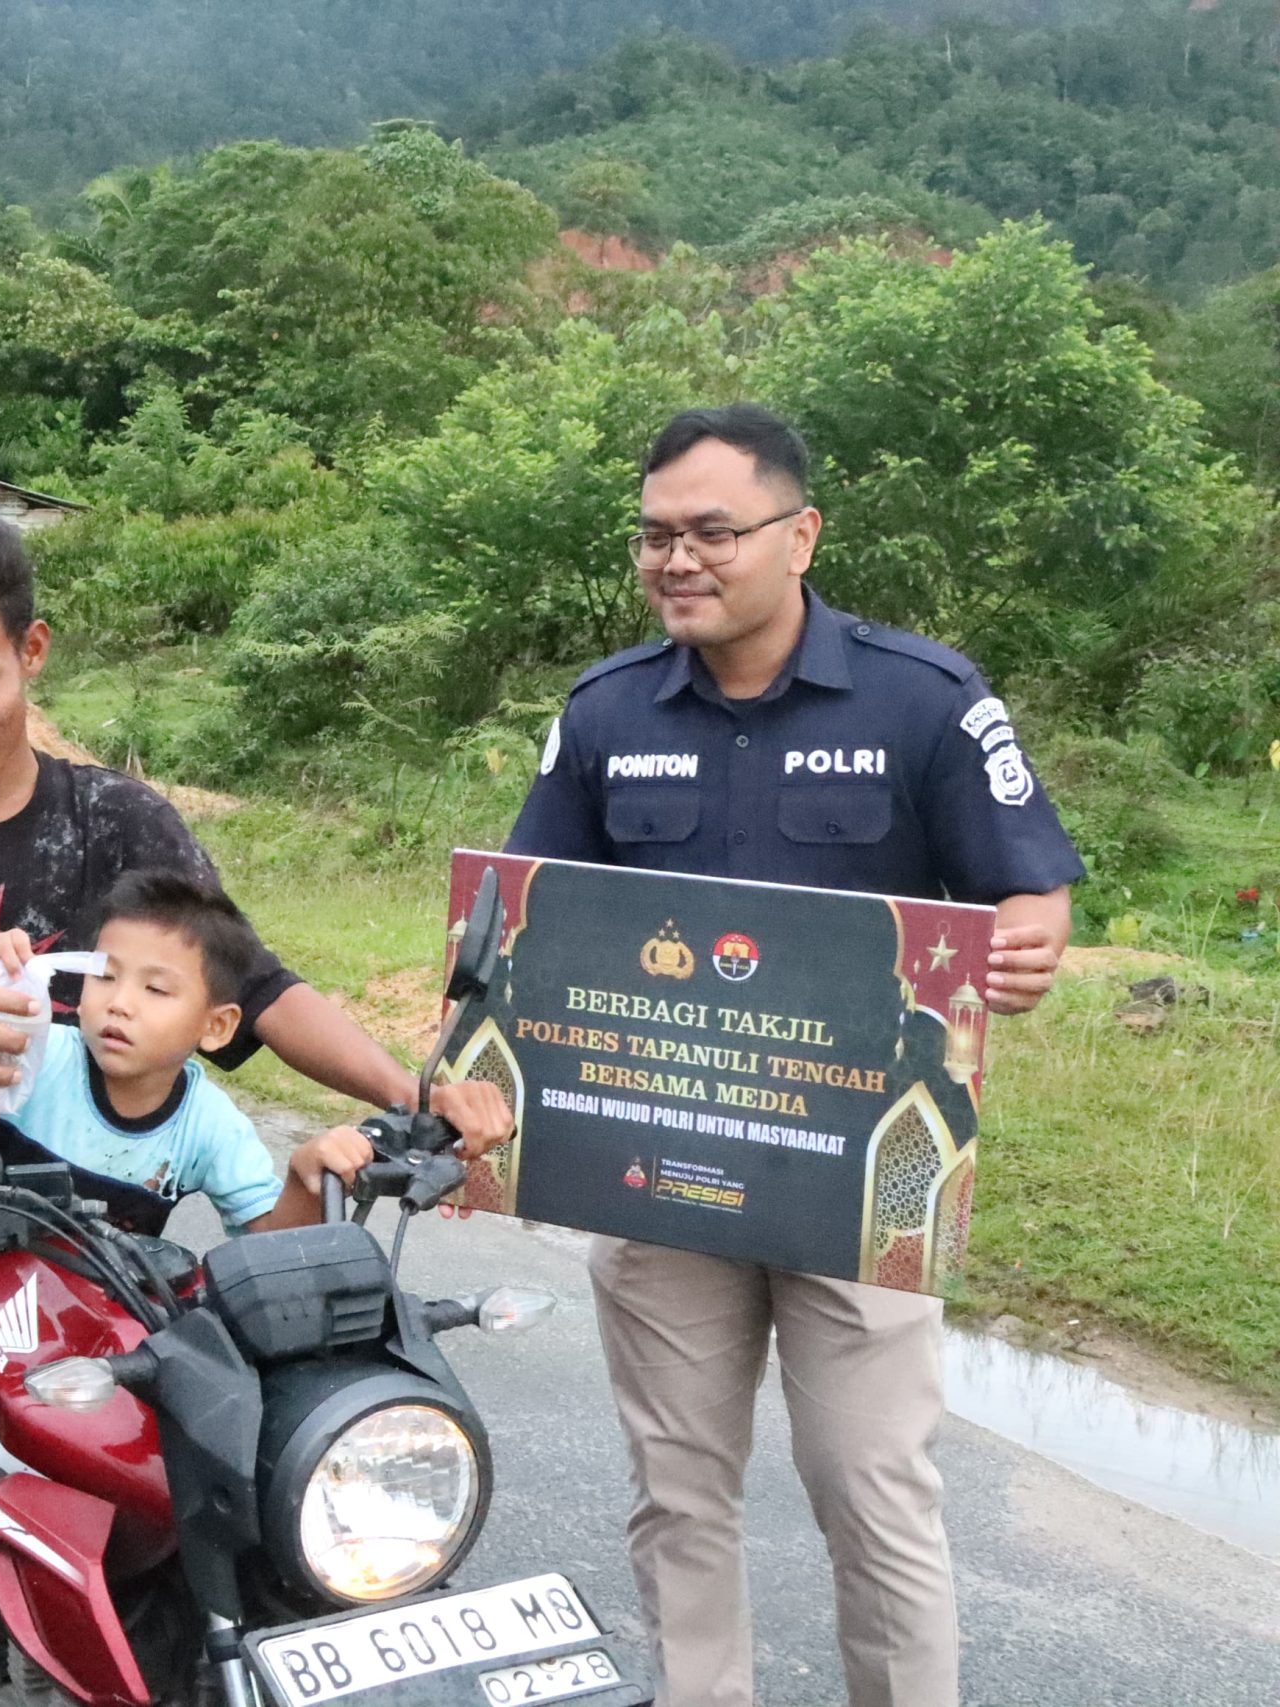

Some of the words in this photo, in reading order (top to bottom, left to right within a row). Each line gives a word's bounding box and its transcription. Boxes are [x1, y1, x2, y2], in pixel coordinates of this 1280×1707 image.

[607, 753, 699, 778] PONITON
[784, 748, 886, 775] POLRI
[566, 986, 709, 1028] BERBAGI
[718, 1007, 834, 1046] TAKJIL
[515, 1018, 620, 1052] POLRES
[626, 1034, 760, 1074] TAPANULI
[767, 1055, 887, 1094] TENGAH
[578, 1061, 708, 1101] BERSAMA
[715, 1082, 809, 1117] MEDIA
[541, 1087, 600, 1115] SEBAGAI
[601, 1097, 650, 1124] WUJUD
[652, 1103, 694, 1131] POLRI
[696, 1113, 745, 1140] UNTUK
[747, 1122, 847, 1156] MASYARAKAT
[660, 1169, 694, 1181] MENUJU
[695, 1175, 720, 1185] POLRI
[721, 1180, 745, 1190] YANG
[661, 1158, 725, 1176] TRANSFORMASI
[656, 1179, 745, 1207] PRESISI
[281, 1641, 353, 1699] BB
[369, 1607, 498, 1673] 6018
